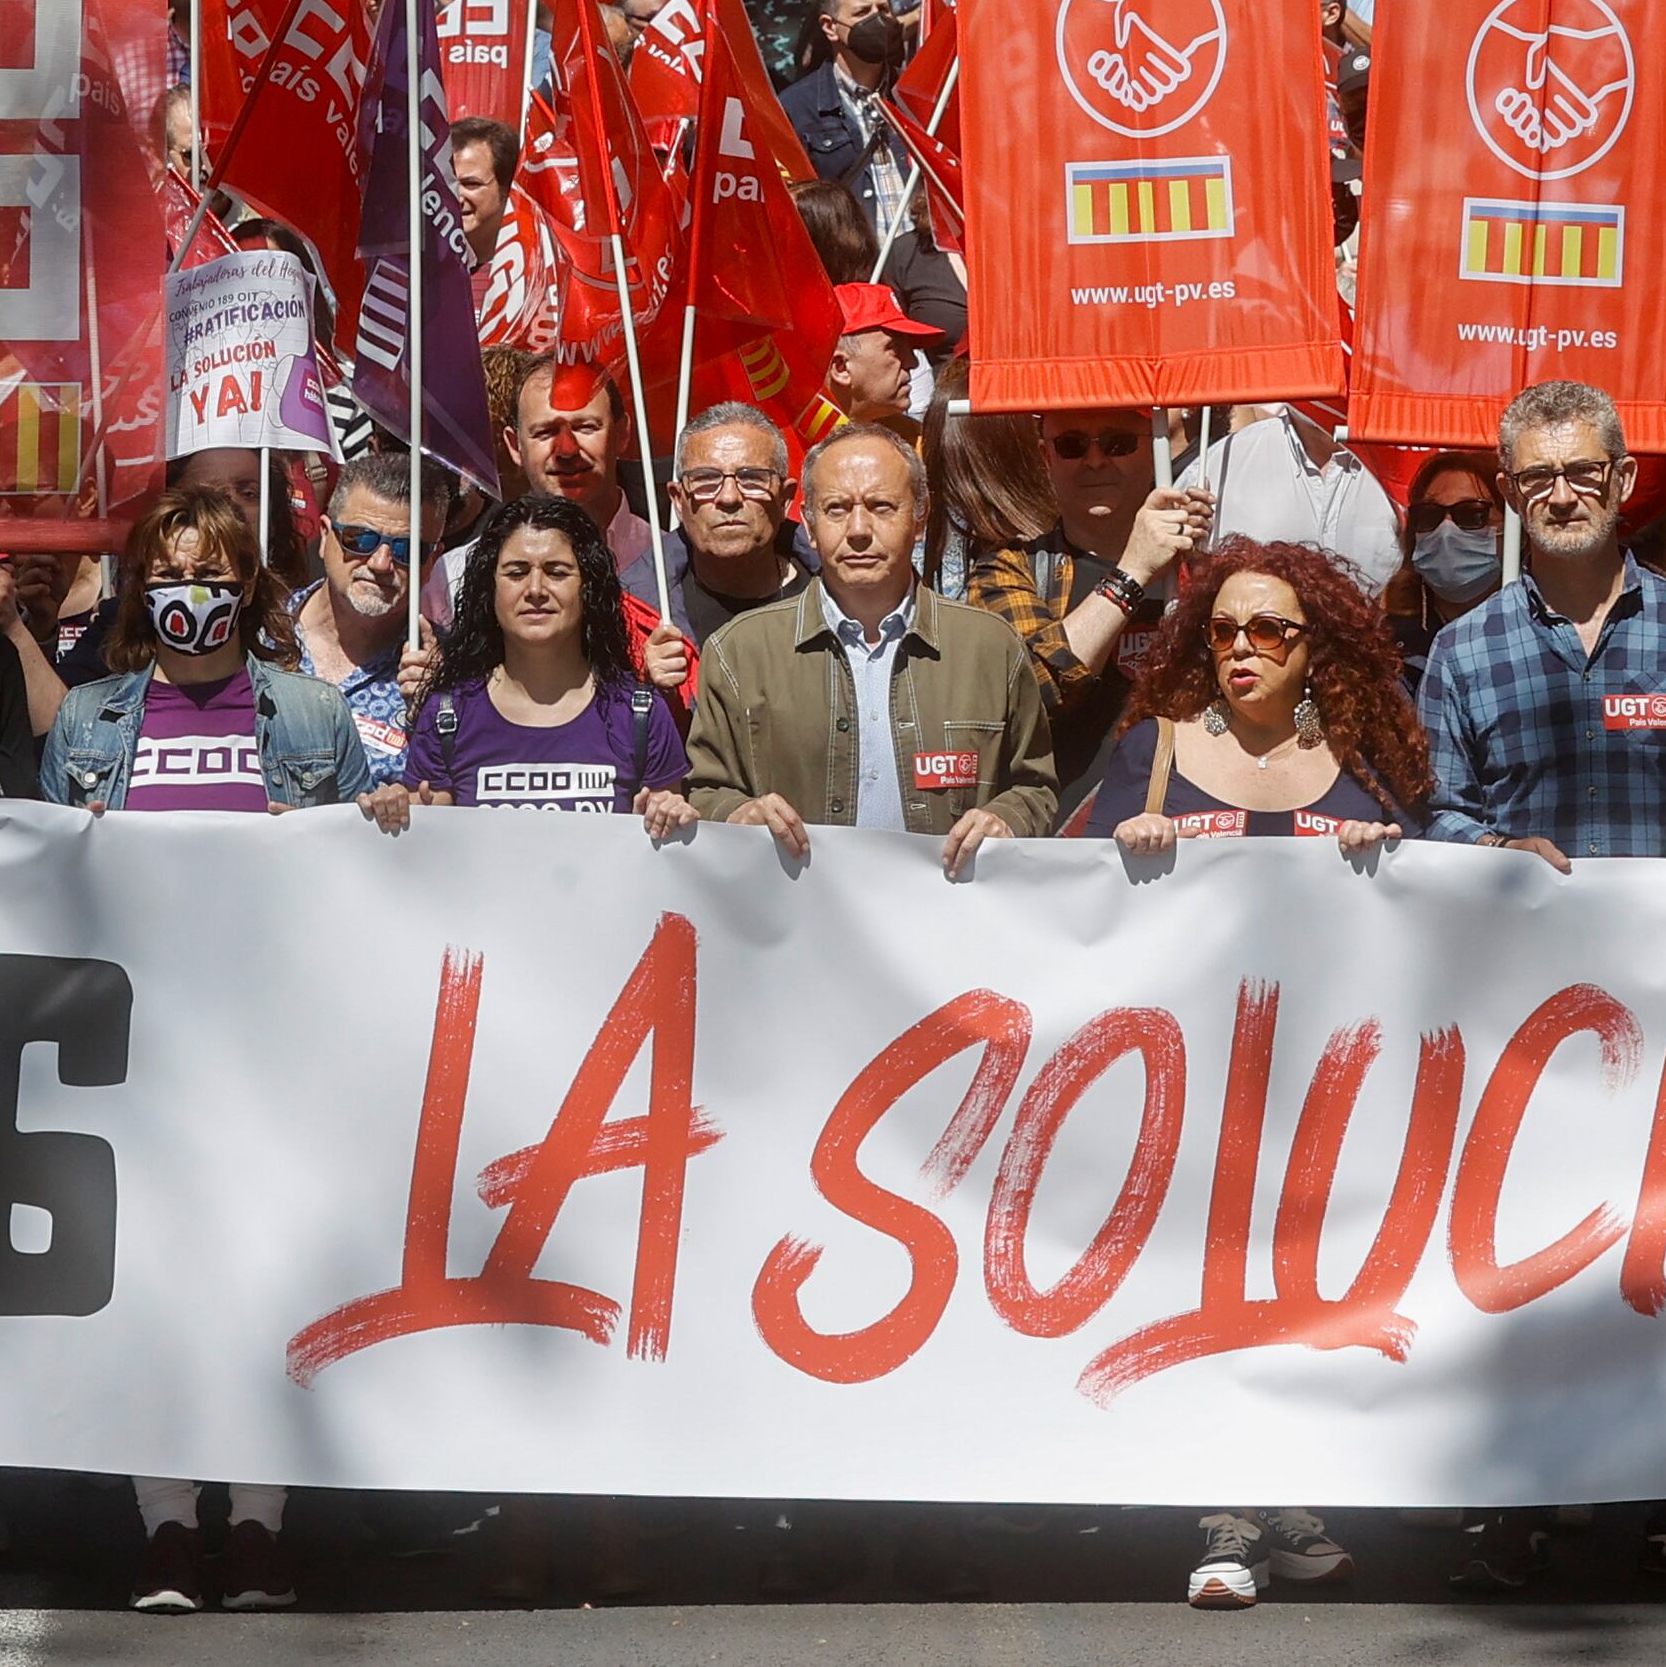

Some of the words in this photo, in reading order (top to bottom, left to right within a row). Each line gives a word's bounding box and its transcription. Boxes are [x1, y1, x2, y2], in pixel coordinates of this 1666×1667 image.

[267, 61, 321, 103] aís
[175, 263, 246, 298] Trabajadoras
[252, 258, 276, 279] del
[168, 300, 215, 323] CONVENIO
[217, 293, 234, 310] 189
[237, 291, 259, 303] OIT
[1070, 280, 1237, 308] www.ugt-pv.es
[183, 294, 306, 347] #RATIFICACIÓN
[1456, 322, 1619, 351] www.ugt-pv.es
[170, 367, 189, 393] LA
[194, 334, 277, 379] SOLUCIÓN
[189, 370, 263, 426] YA!
[1604, 698, 1650, 717] UGT
[1629, 718, 1647, 727] País
[915, 754, 958, 775] UGT
[484, 771, 570, 792] CCOO
[1296, 812, 1338, 833] UGT
[286, 911, 726, 1390] LA
